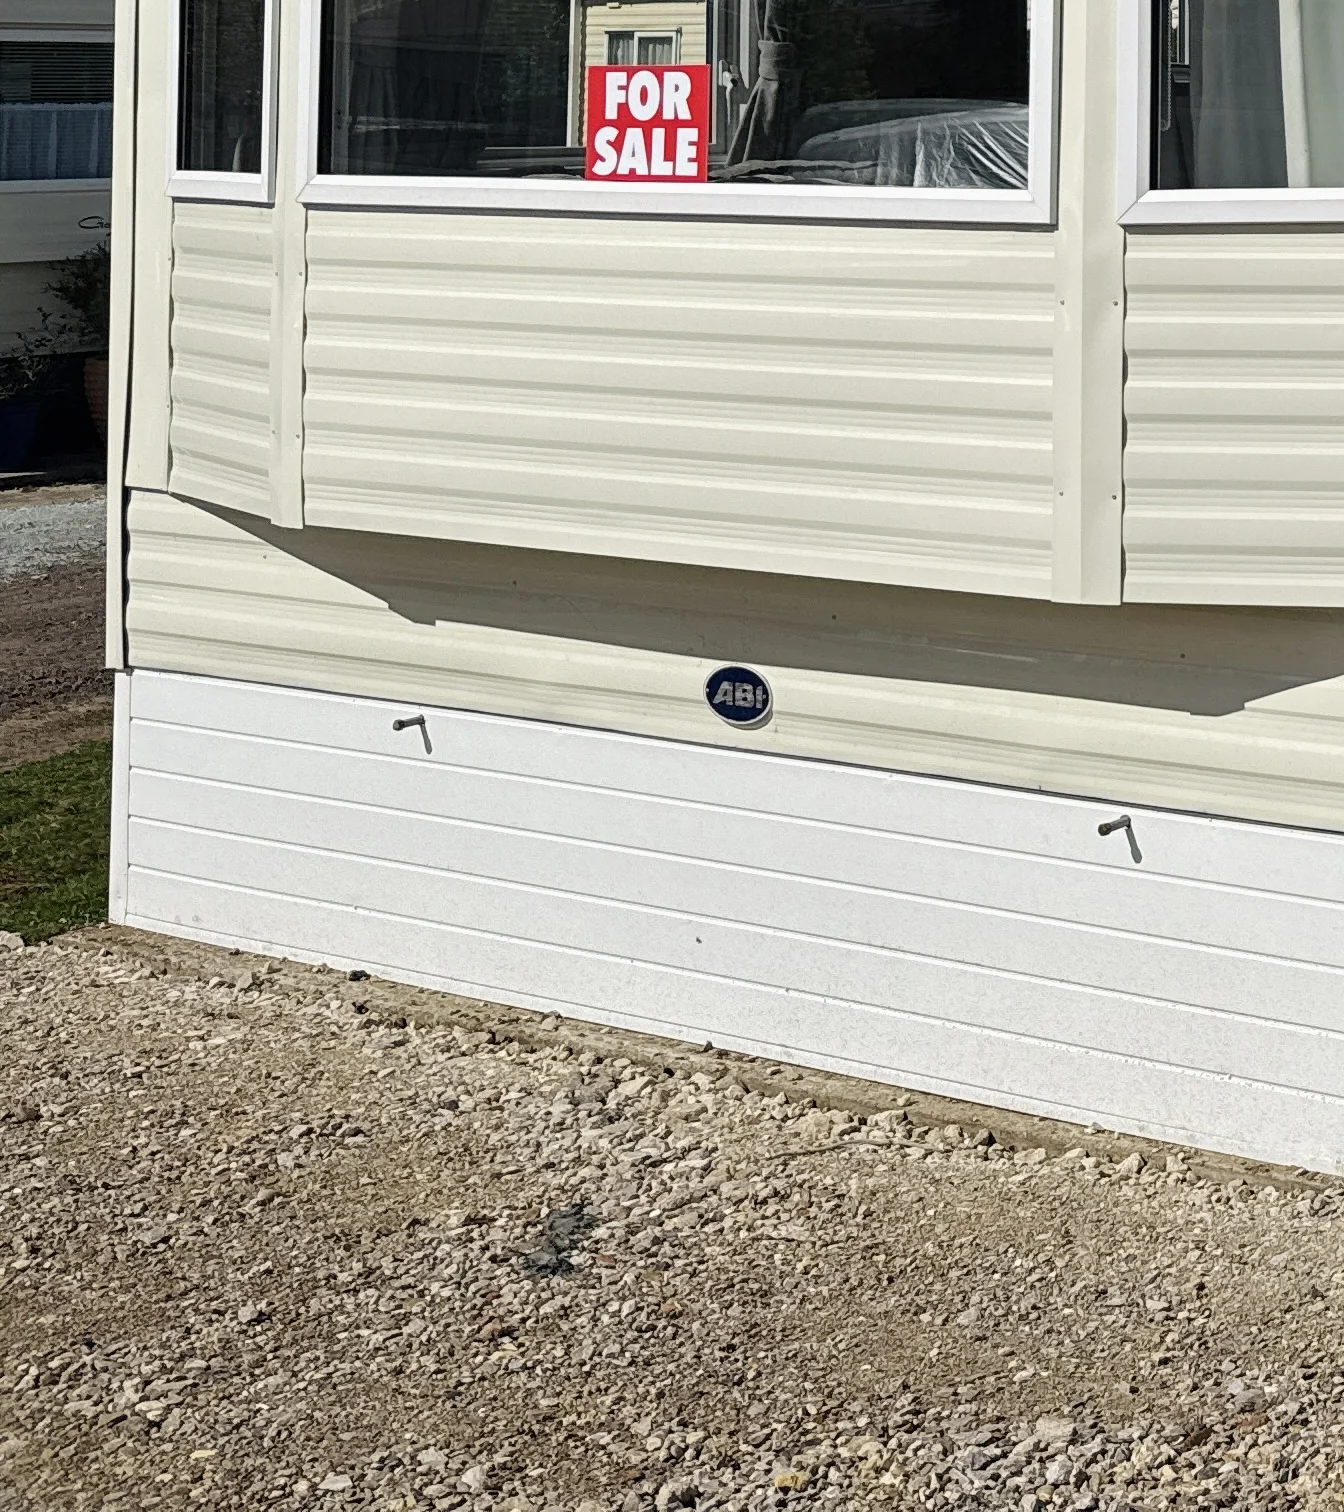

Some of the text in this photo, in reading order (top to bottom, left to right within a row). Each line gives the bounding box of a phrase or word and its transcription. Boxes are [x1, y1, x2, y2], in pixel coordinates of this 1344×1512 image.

[604, 70, 692, 121] FOR
[591, 125, 699, 177] SALE
[712, 680, 763, 708] ABI
